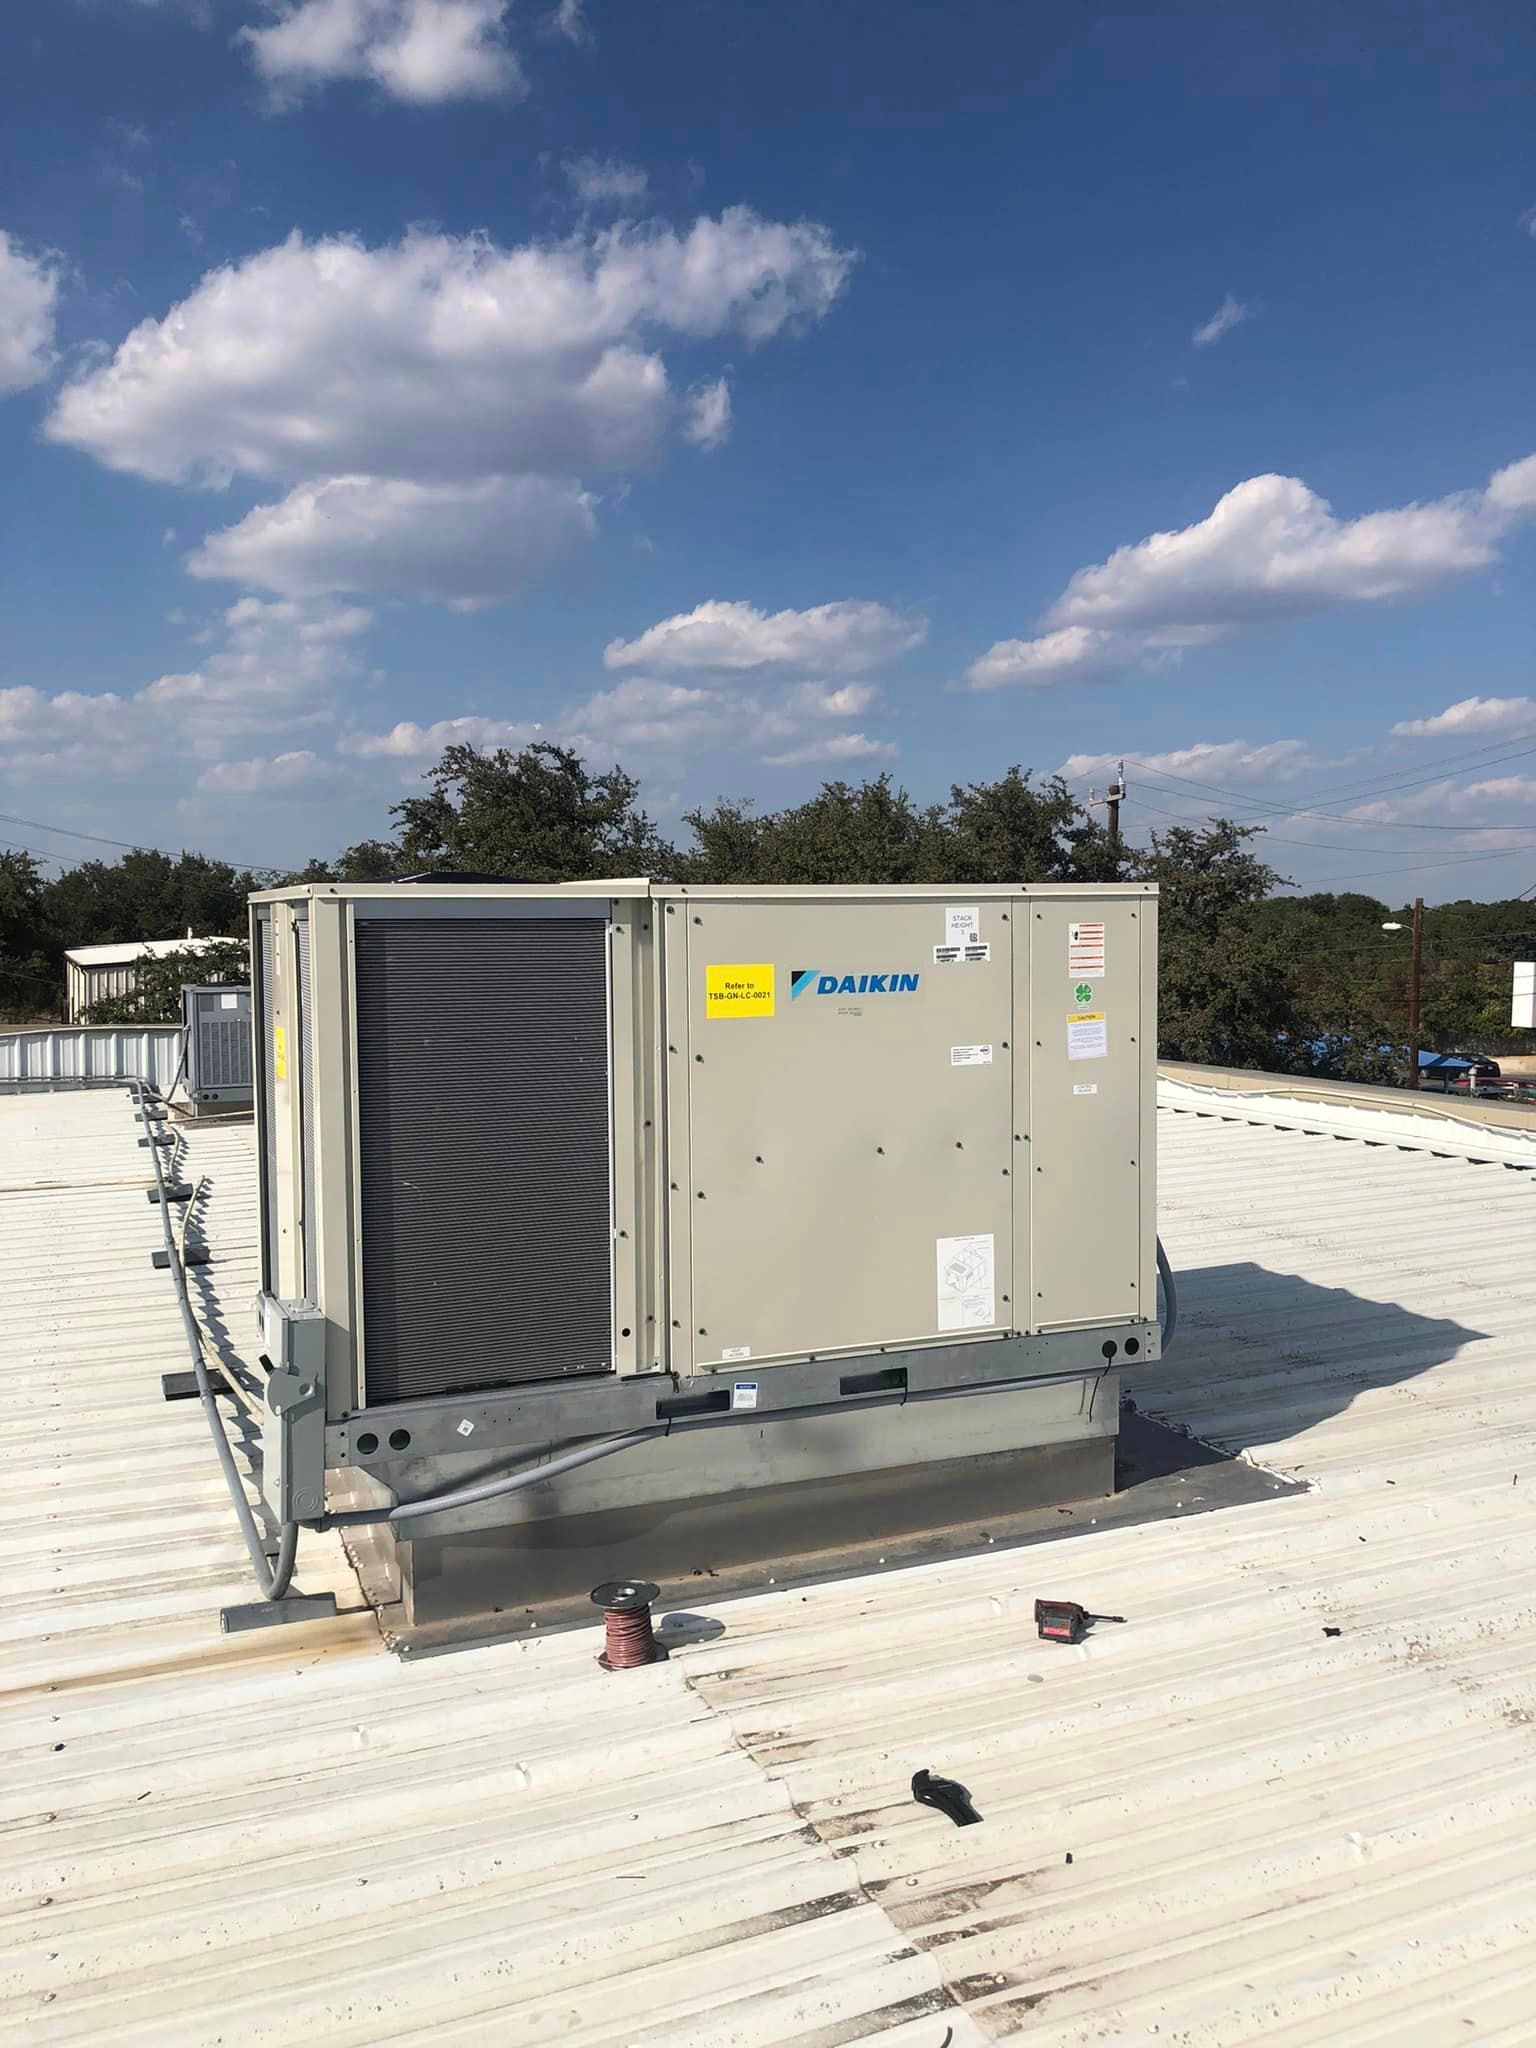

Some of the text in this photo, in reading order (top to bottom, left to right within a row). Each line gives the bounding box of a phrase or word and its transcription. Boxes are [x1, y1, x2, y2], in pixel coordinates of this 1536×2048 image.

[952, 914, 973, 922] STACK
[950, 921, 974, 929] HEIGHT
[724, 982, 745, 990] Refer
[817, 973, 920, 995] DAIKIN
[708, 991, 771, 1000] TSB-GN-LC-0021
